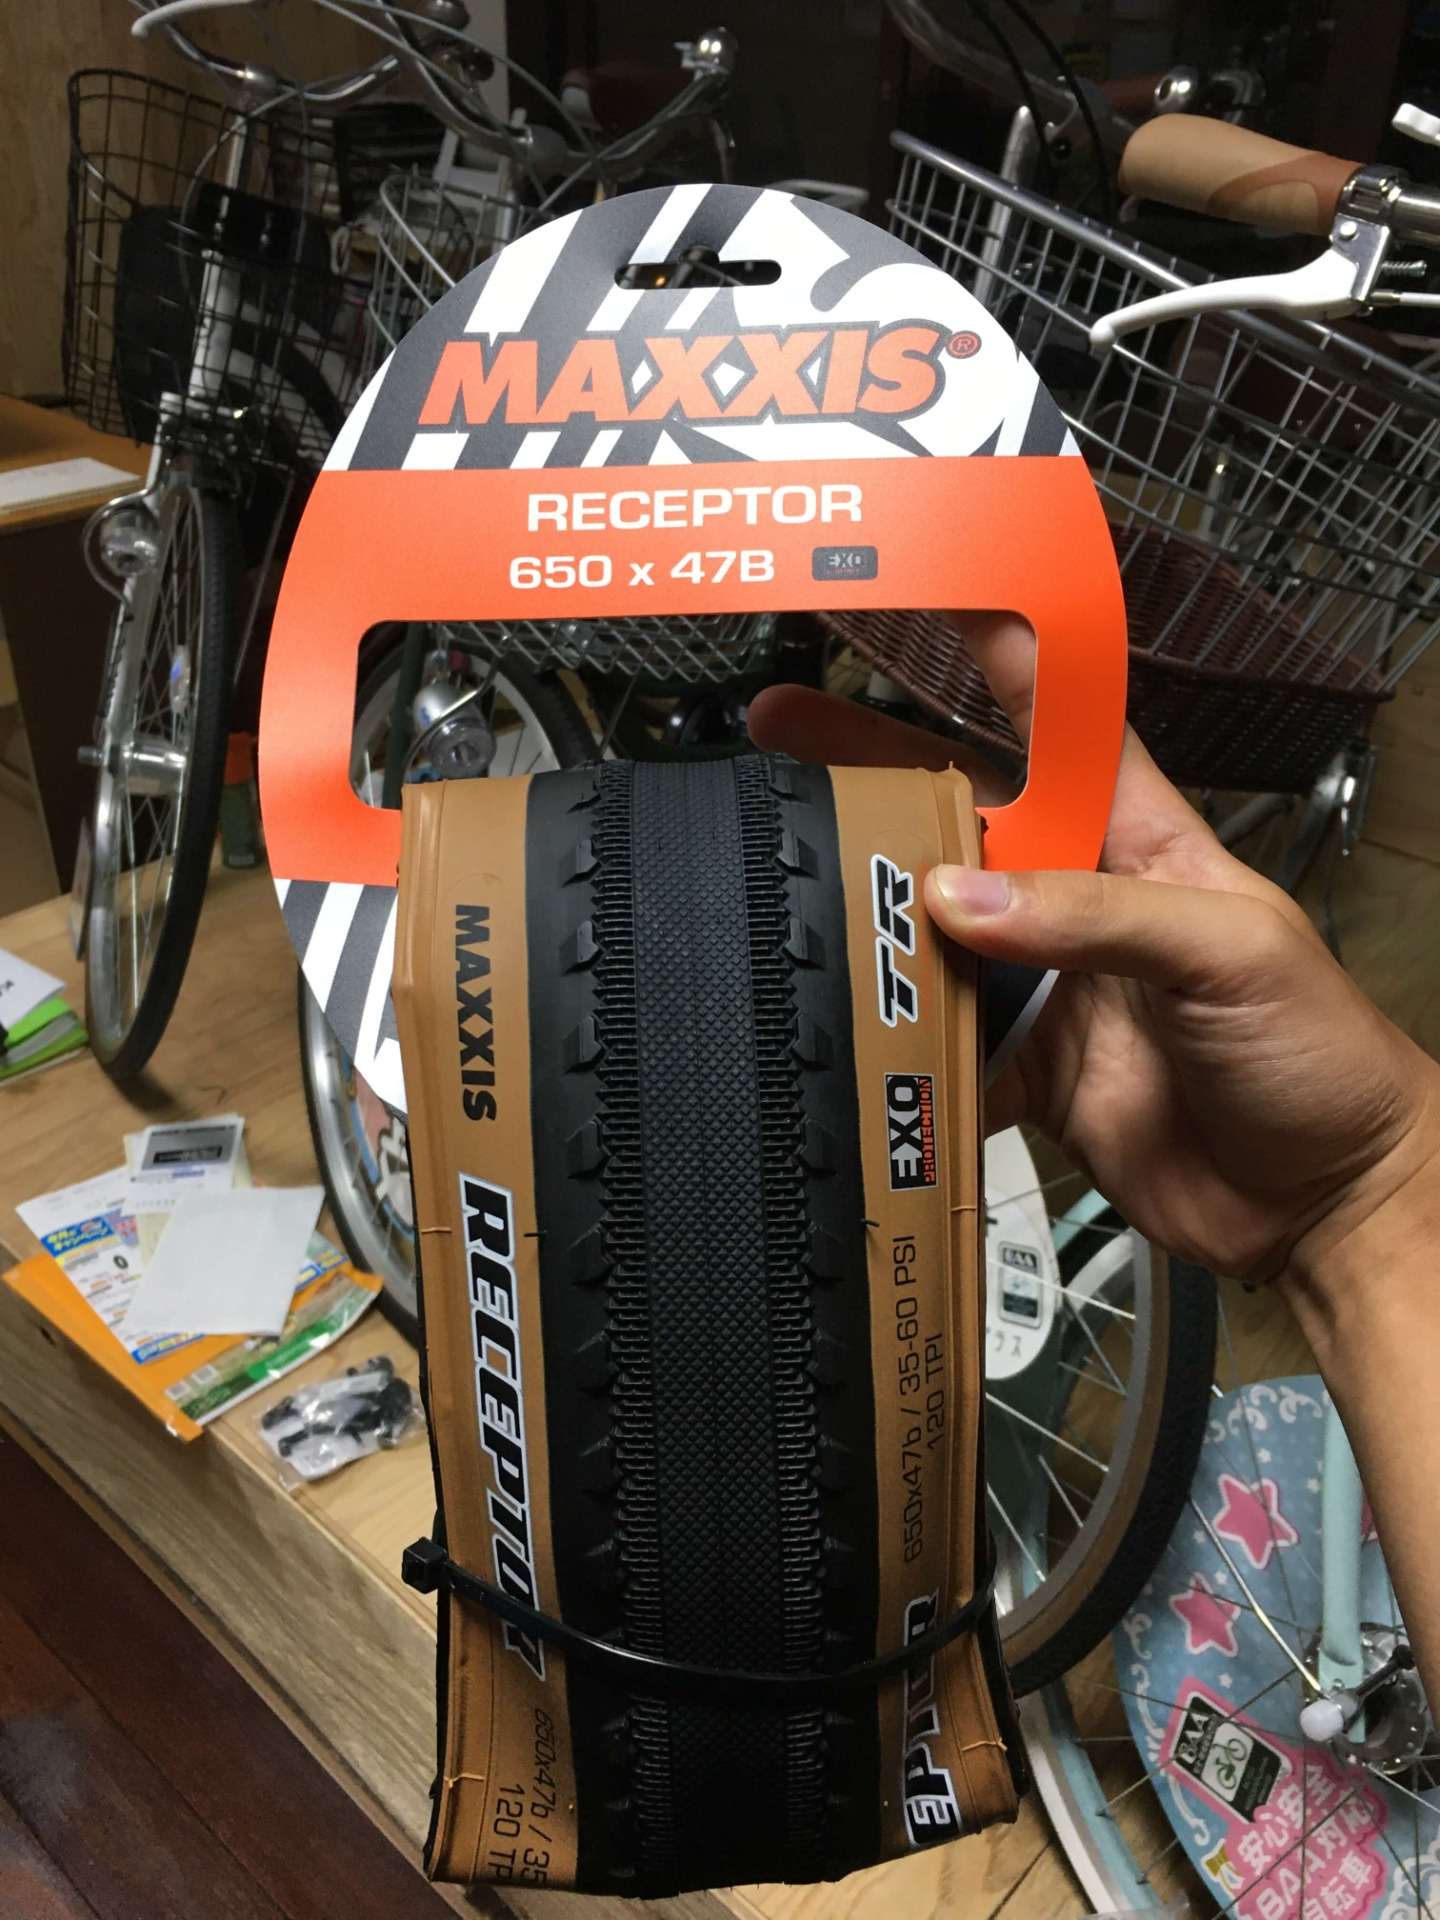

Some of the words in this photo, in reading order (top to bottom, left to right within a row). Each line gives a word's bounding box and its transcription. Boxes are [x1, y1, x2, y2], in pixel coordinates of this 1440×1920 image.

[528, 484, 863, 532] RECEPTOR
[509, 555, 612, 590] 650
[628, 561, 655, 586] x
[670, 549, 775, 585] 47B
[870, 853, 918, 1028] TR
[455, 904, 497, 1121] MAXXIS
[885, 1073, 922, 1189] EXO
[892, 1235, 917, 1286] PSI
[896, 1296, 921, 1396] 35-60
[924, 1333, 944, 1384] TPI
[926, 1389, 945, 1450] 120
[902, 1426, 923, 1564] 650x47b
[529, 1707, 557, 1819] 650x47b
[1180, 1712, 1208, 1765] BAA
[493, 1783, 526, 1838] 120
[1237, 1764, 1335, 1876] 安心安全
